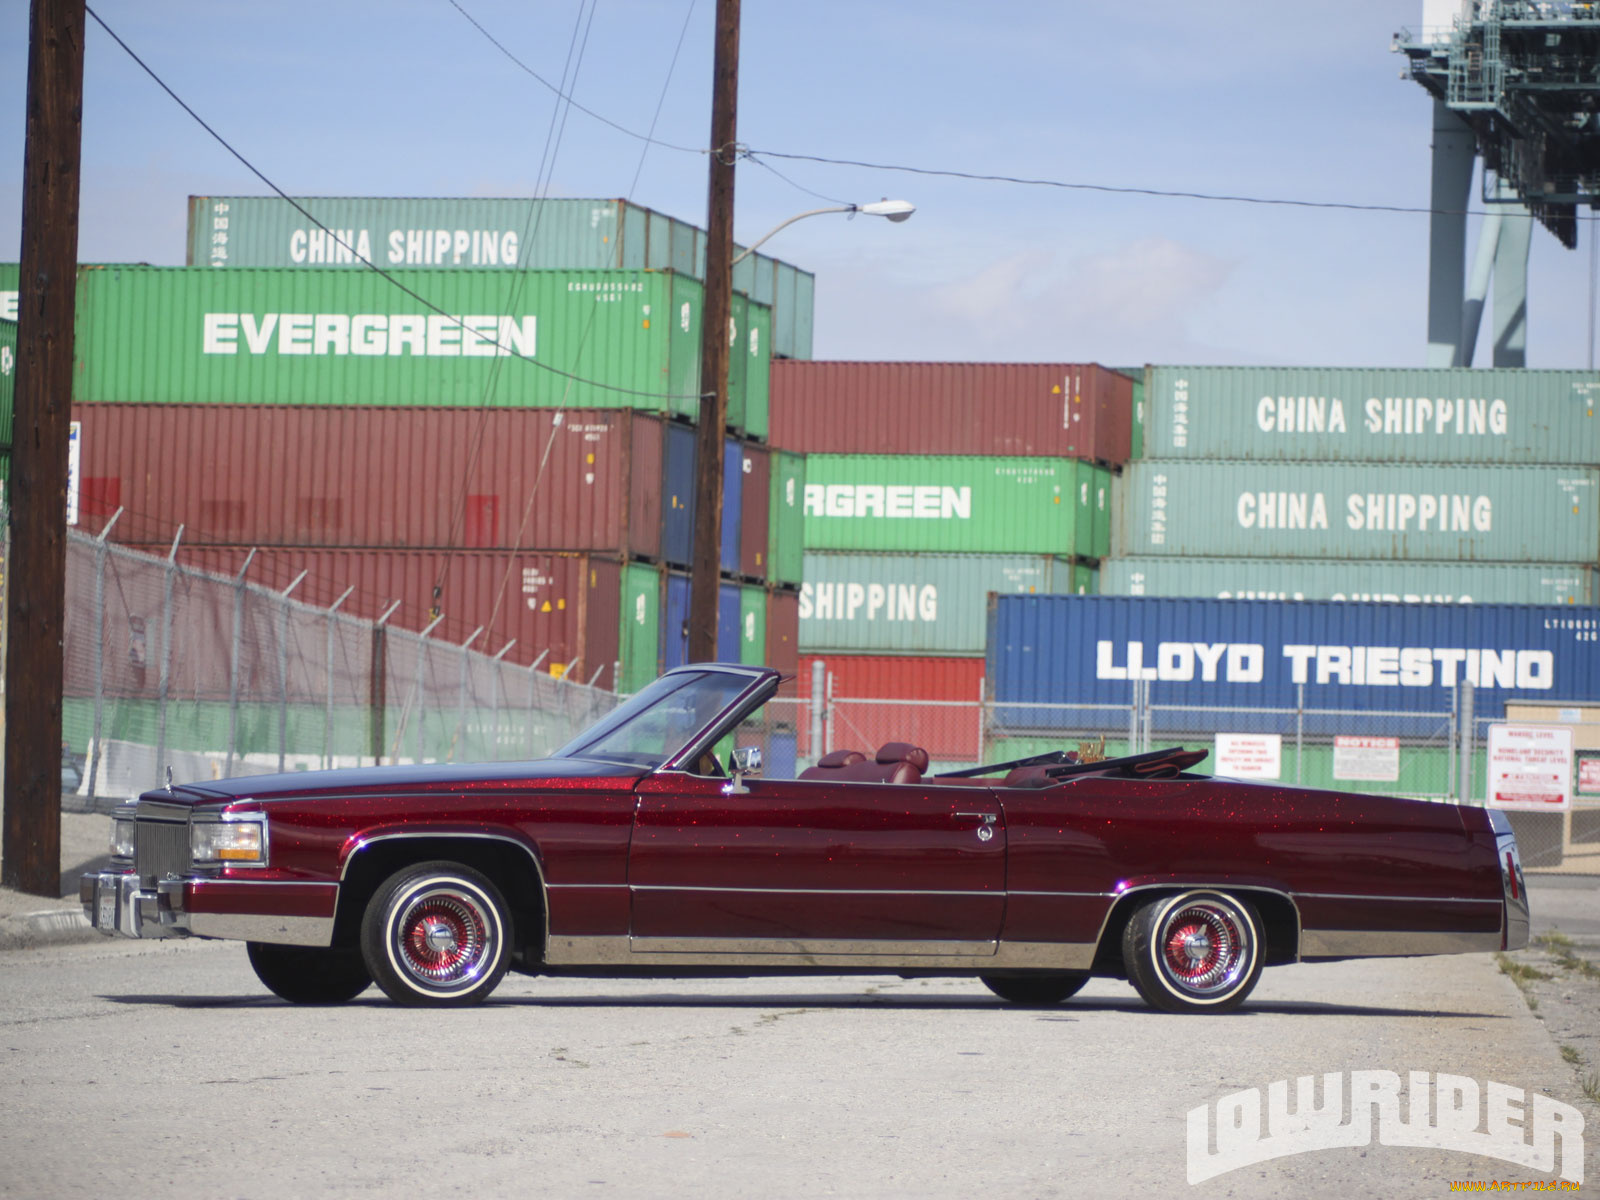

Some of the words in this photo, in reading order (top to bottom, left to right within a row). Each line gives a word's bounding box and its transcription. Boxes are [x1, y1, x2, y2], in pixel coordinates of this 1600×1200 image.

[290, 228, 372, 264] CHINA
[388, 229, 519, 265] SHIPPING
[203, 312, 537, 357] EVERGREEN
[1257, 396, 1346, 433] CHINA
[1365, 398, 1507, 435] SHIPPING
[1237, 491, 1328, 529] CHINA
[1346, 493, 1492, 532] SHIPPING
[798, 582, 937, 621] SHIPPING
[1096, 640, 1264, 682] LLOYD
[1282, 644, 1554, 690] TRIESTINO
[1337, 737, 1396, 749] NOTICE
